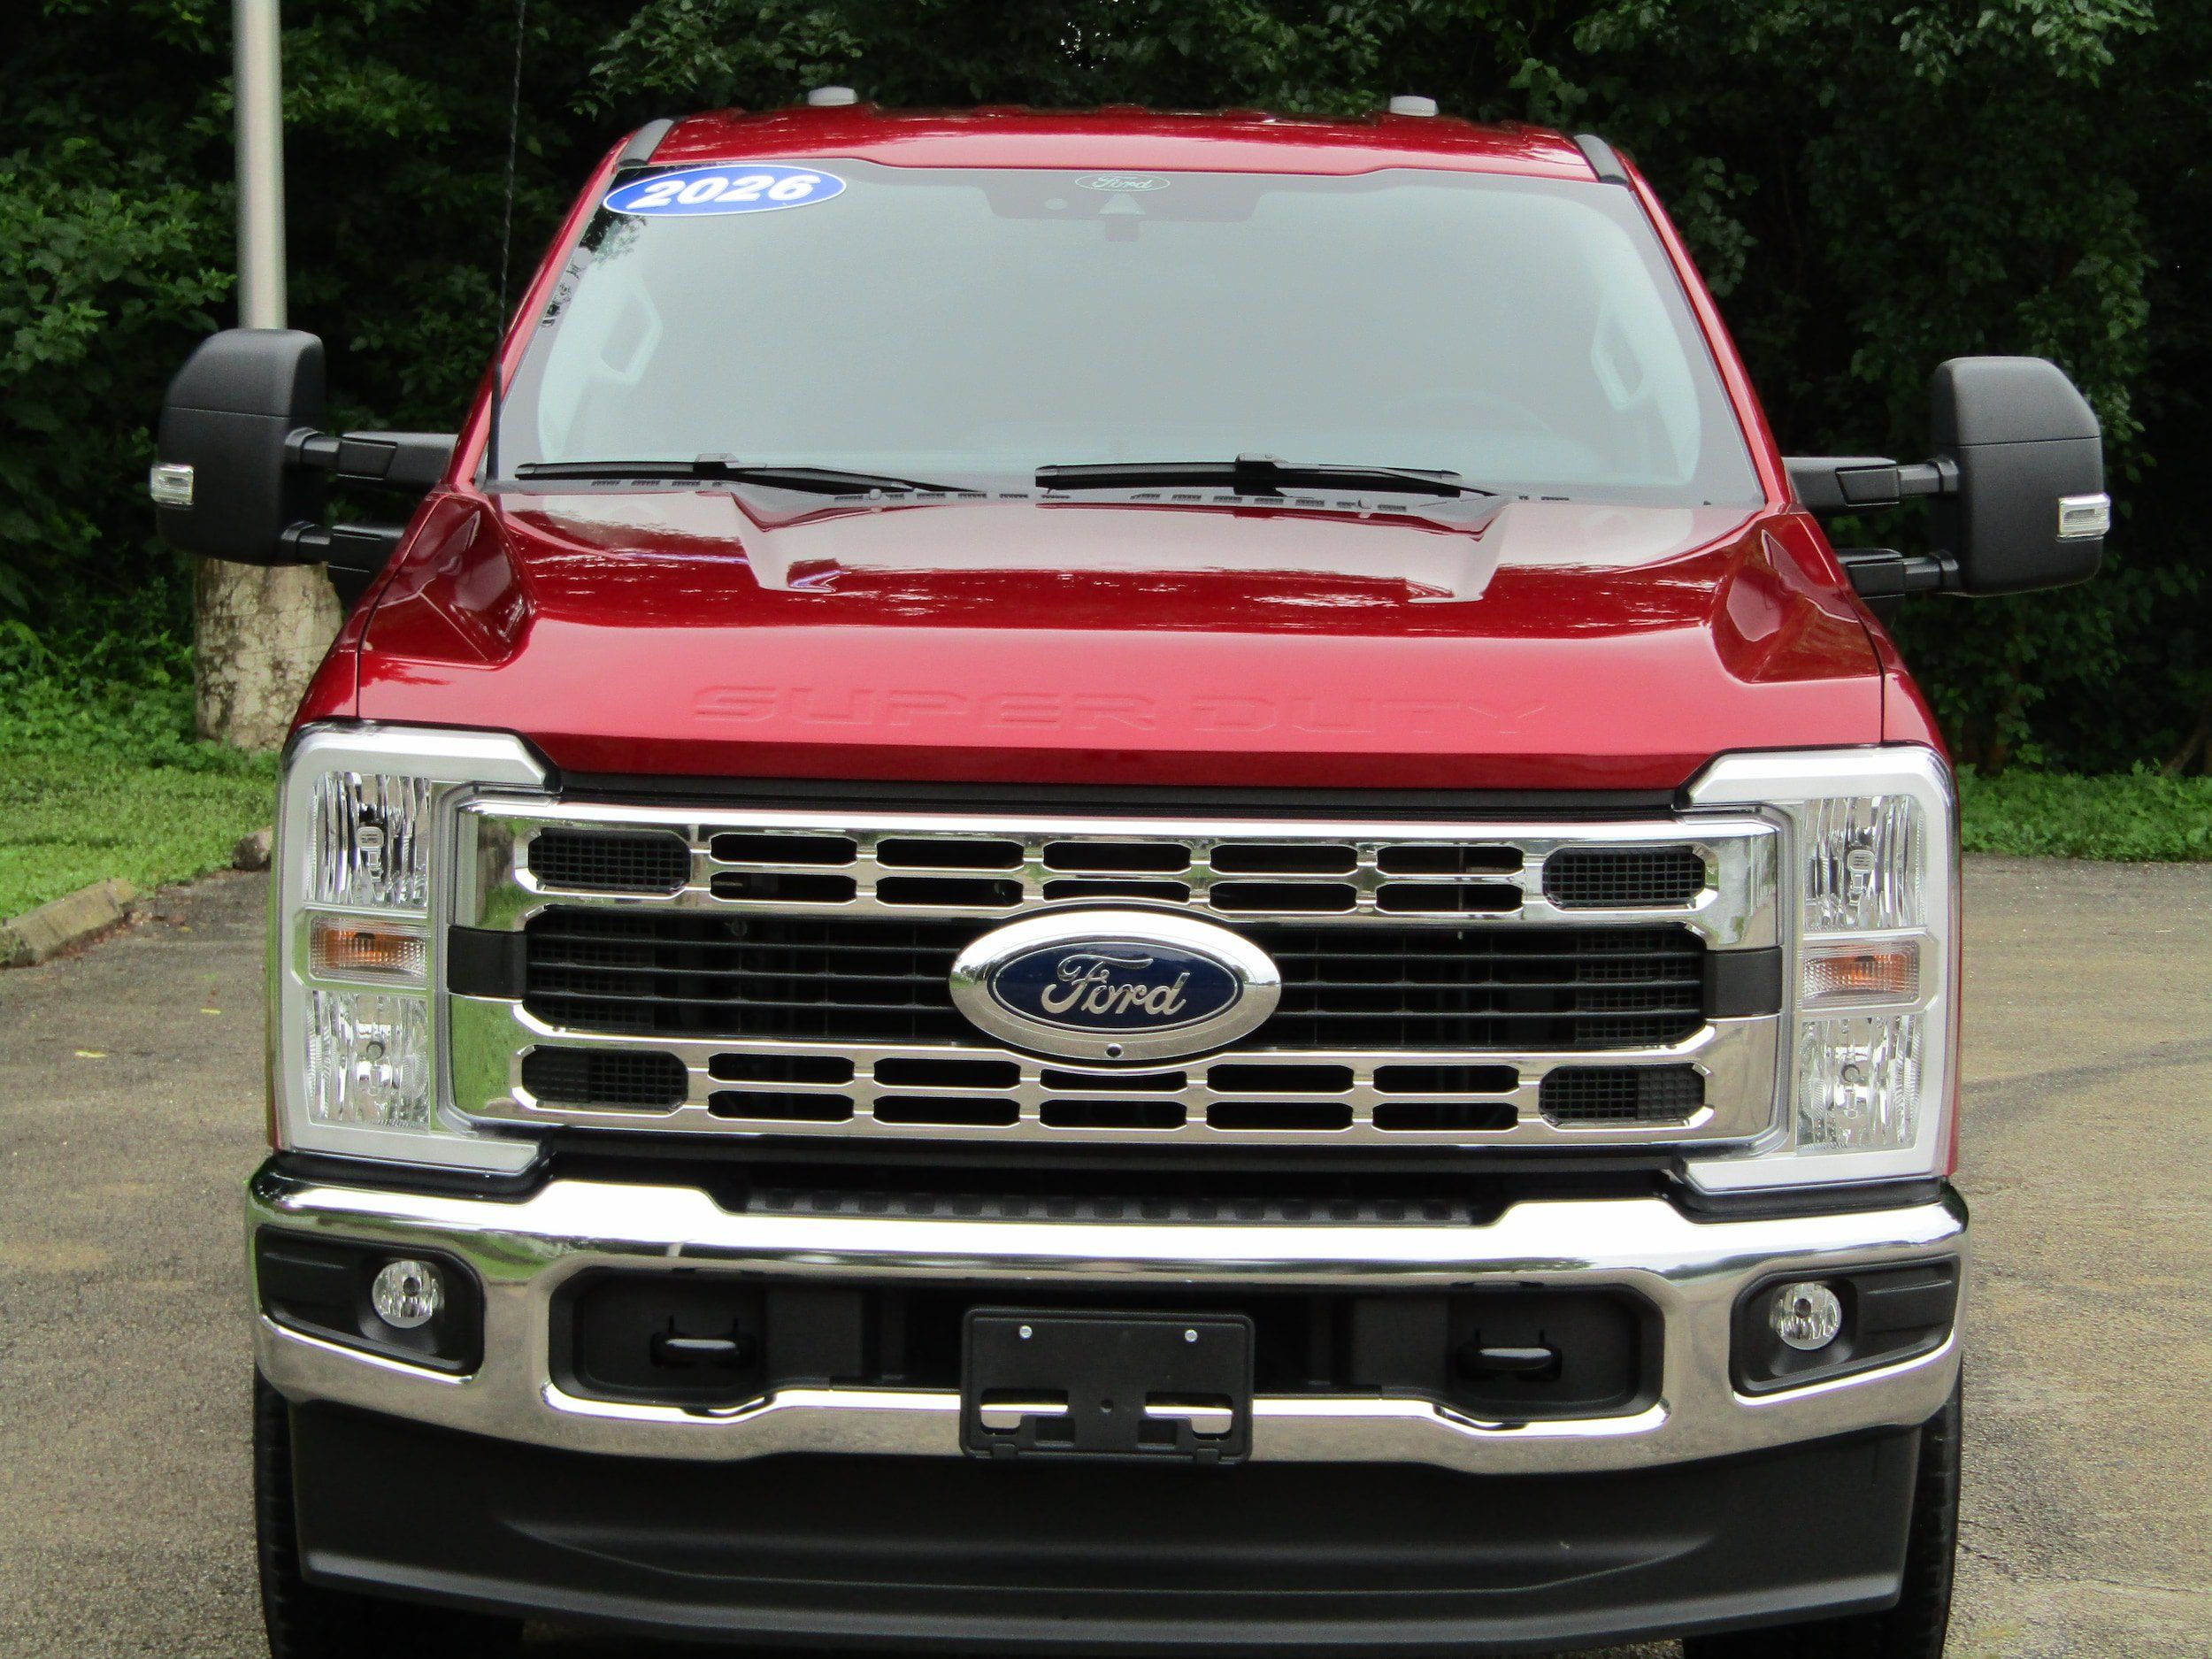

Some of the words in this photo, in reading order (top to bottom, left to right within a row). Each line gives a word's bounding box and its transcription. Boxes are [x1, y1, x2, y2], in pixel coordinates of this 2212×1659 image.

[626, 175, 822, 210] 2026
[1092, 176, 1153, 188] Ford
[694, 686, 1156, 732] SUPER
[1192, 695, 1548, 734] DUTY
[1041, 954, 1190, 1016] Ford
